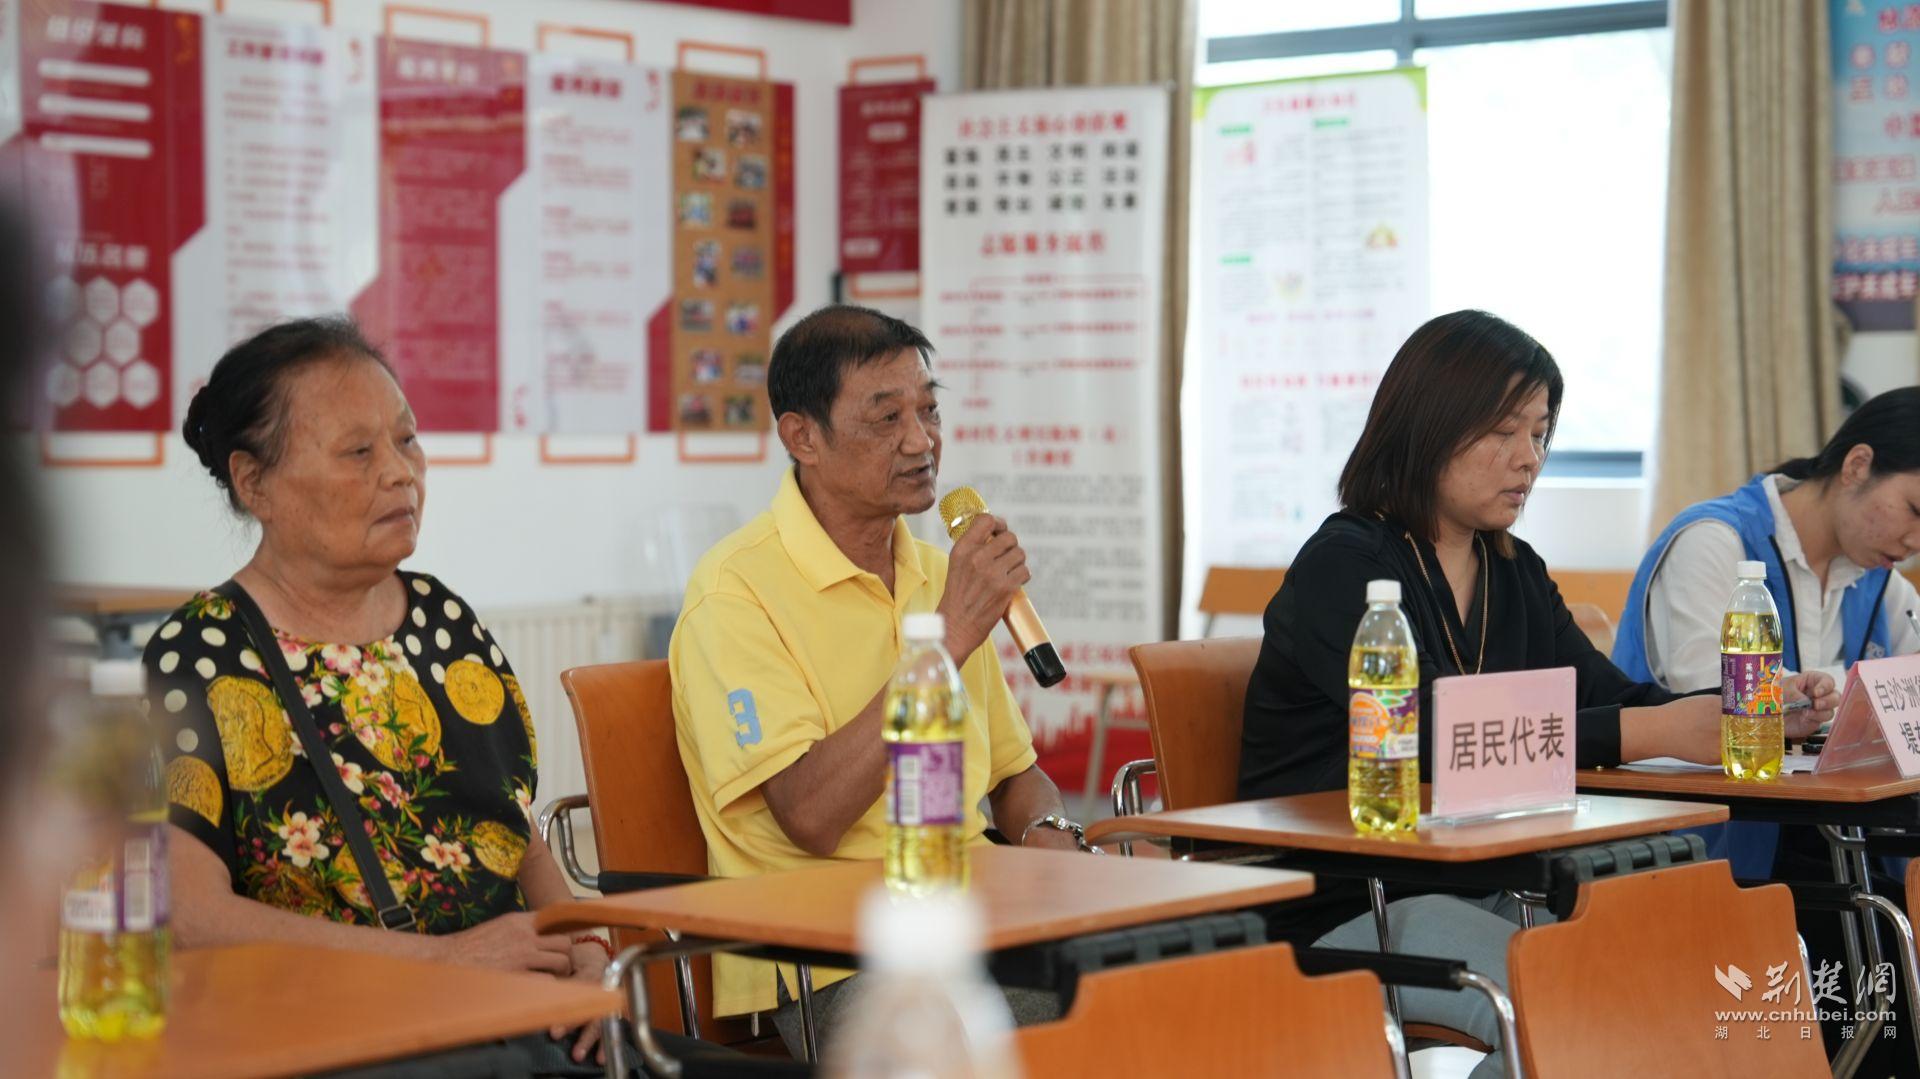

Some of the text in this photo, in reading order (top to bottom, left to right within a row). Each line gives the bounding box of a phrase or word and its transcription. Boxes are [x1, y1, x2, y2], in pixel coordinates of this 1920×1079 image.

[727, 688, 763, 749] 3
[1449, 712, 1565, 771] 居民代表
